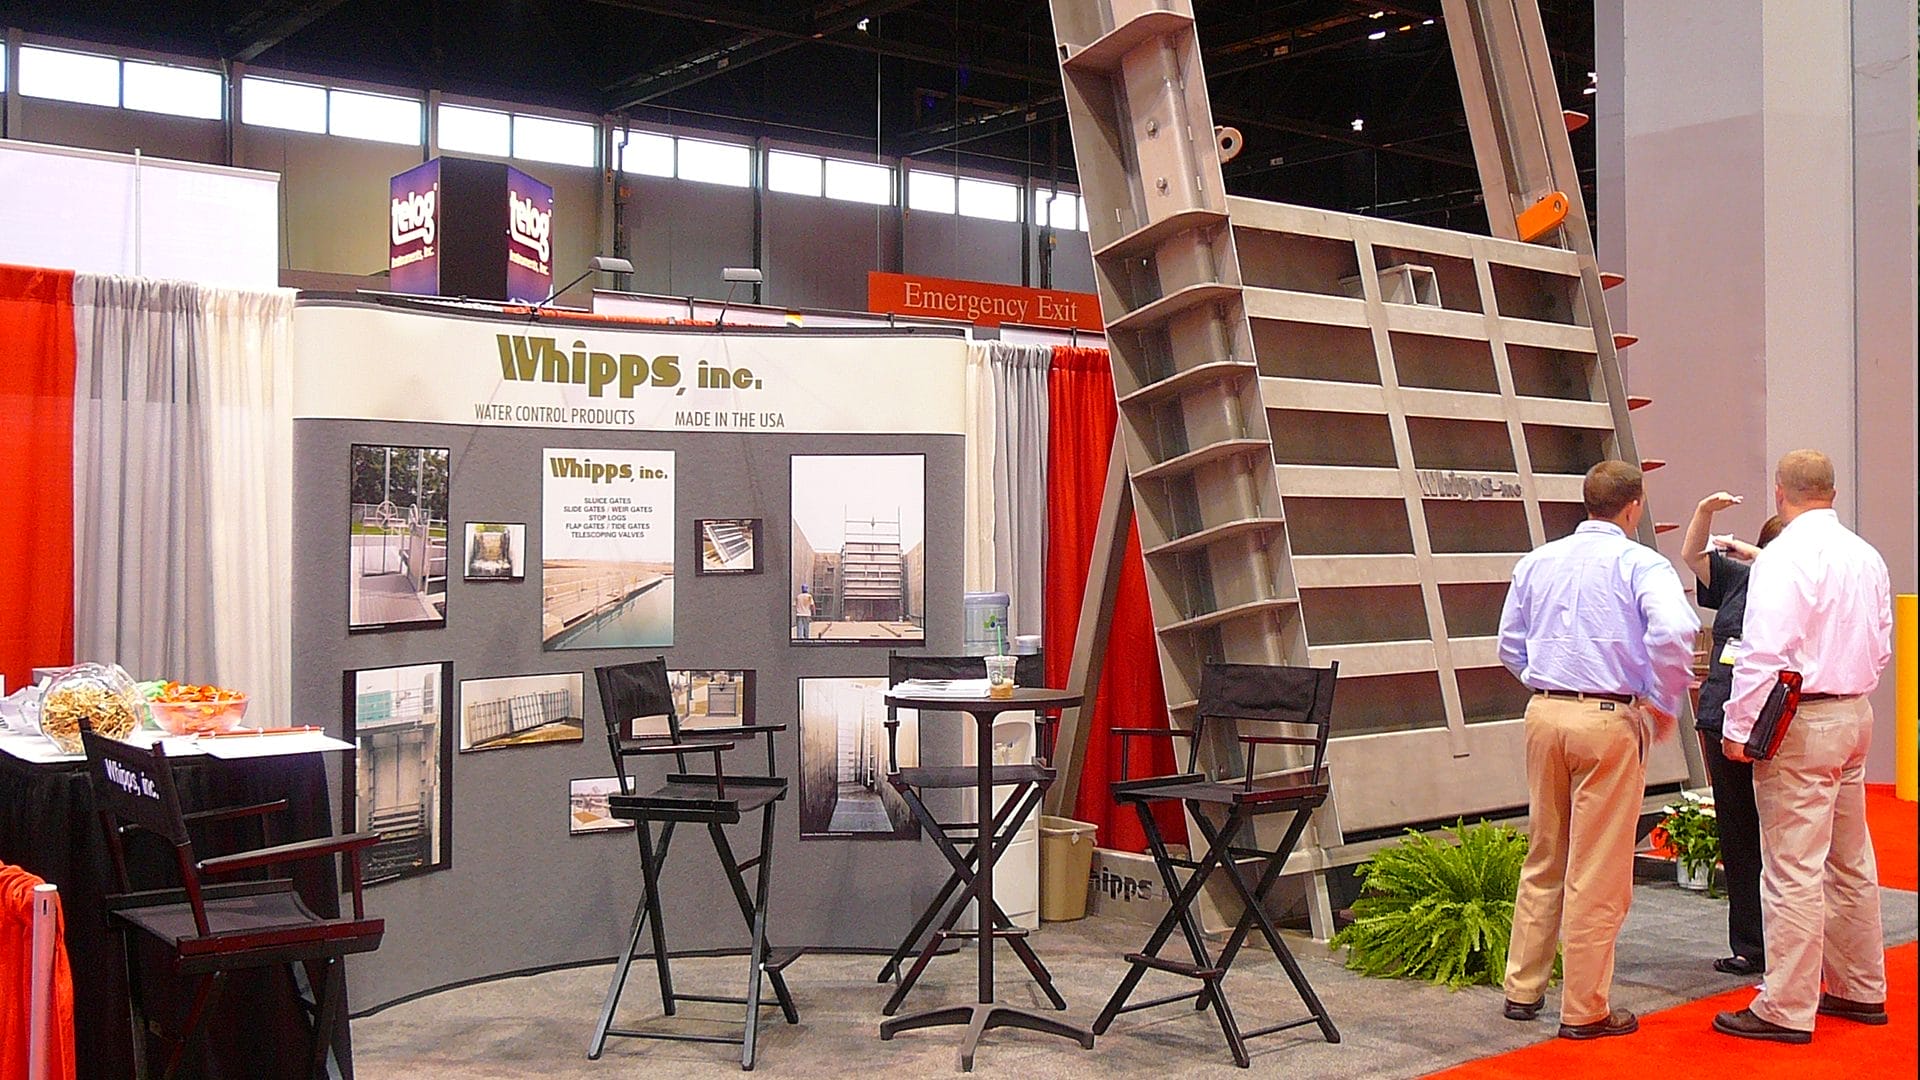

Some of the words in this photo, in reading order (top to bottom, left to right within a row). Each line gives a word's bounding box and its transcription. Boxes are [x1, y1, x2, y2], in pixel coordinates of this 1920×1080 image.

[392, 191, 435, 245] telog
[510, 191, 550, 262] telog
[904, 282, 1028, 322] Emergency
[1037, 295, 1078, 322] Exit
[496, 334, 686, 398] Whipps,
[697, 359, 763, 390] inc.
[475, 403, 512, 420] WATER
[516, 405, 567, 422] CONTROL
[571, 408, 635, 425] PRODUCTS
[675, 411, 711, 427] MADE
[714, 412, 728, 427] IN
[732, 412, 756, 428] THE
[759, 412, 784, 428] USA
[550, 457, 634, 484] Whipps,
[640, 466, 668, 479] inc.
[609, 497, 631, 505] GATES
[141, 771, 160, 800] inc.
[1089, 867, 1152, 903] hipps
